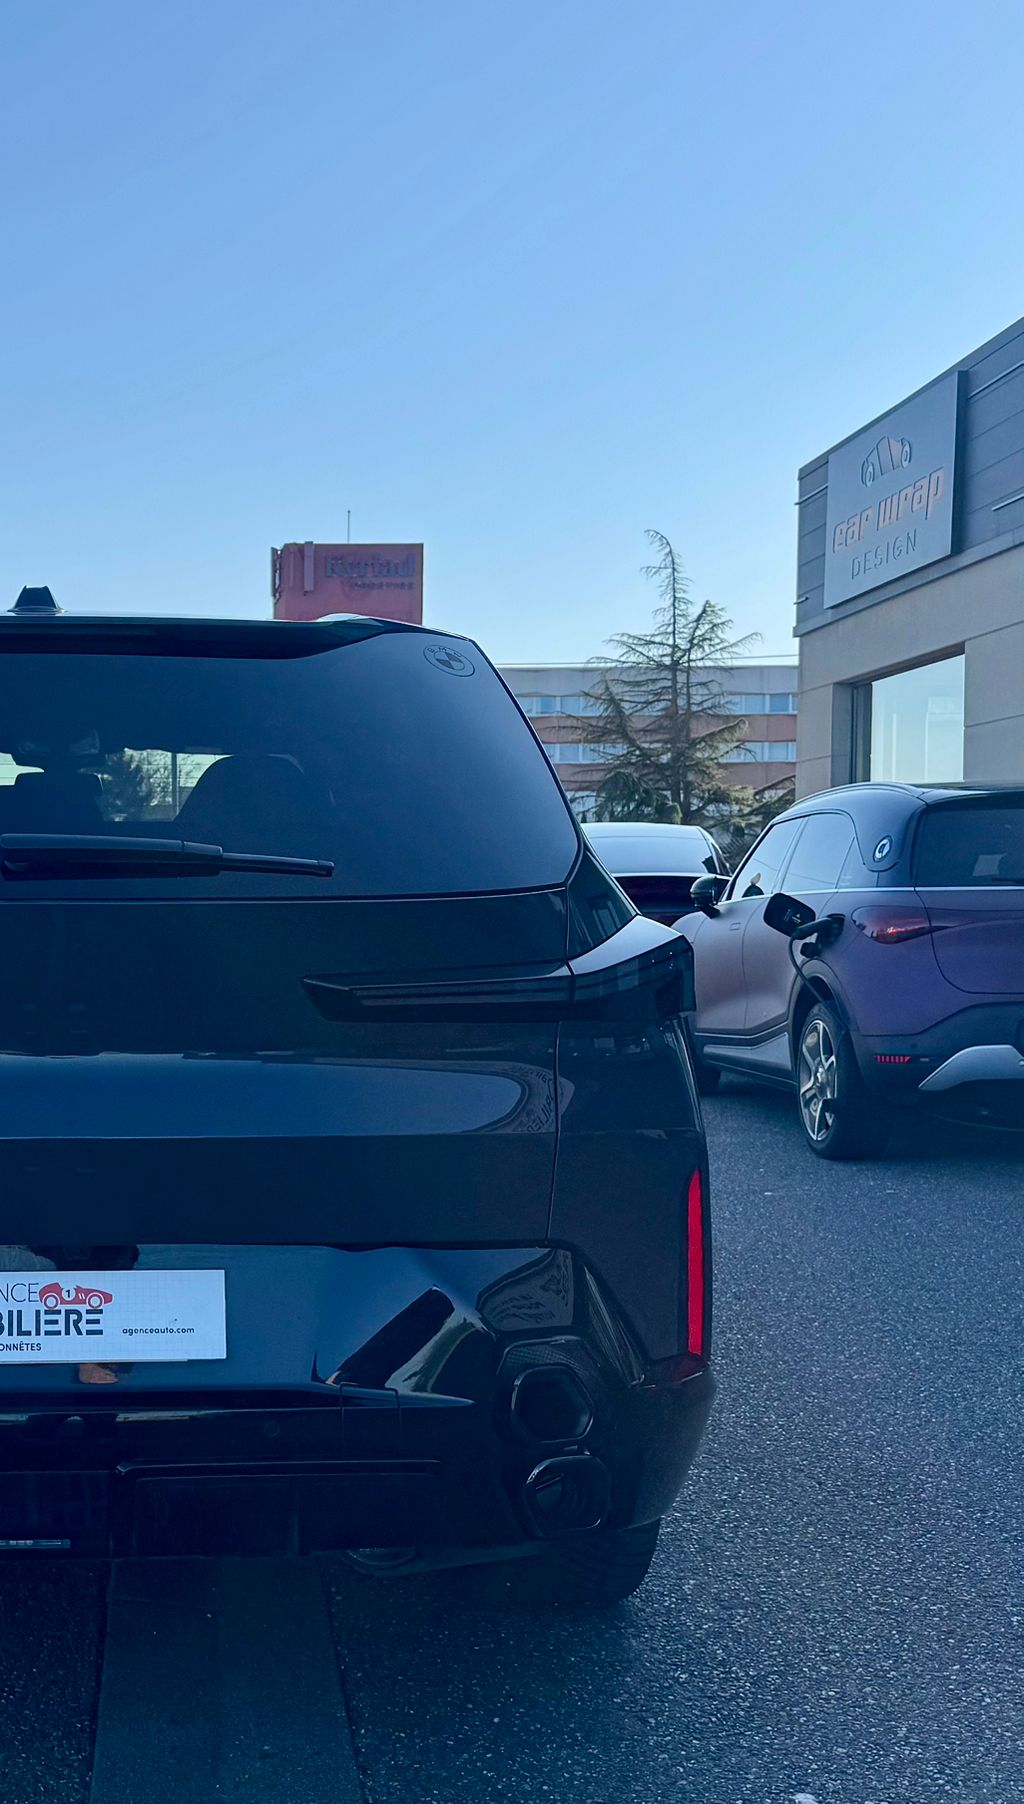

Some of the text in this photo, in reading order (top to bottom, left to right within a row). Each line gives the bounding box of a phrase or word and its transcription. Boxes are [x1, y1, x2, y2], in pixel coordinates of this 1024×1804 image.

[877, 465, 945, 532] wrap
[851, 528, 917, 580] DESIGN
[122, 1327, 195, 1337] agenceauto.com
